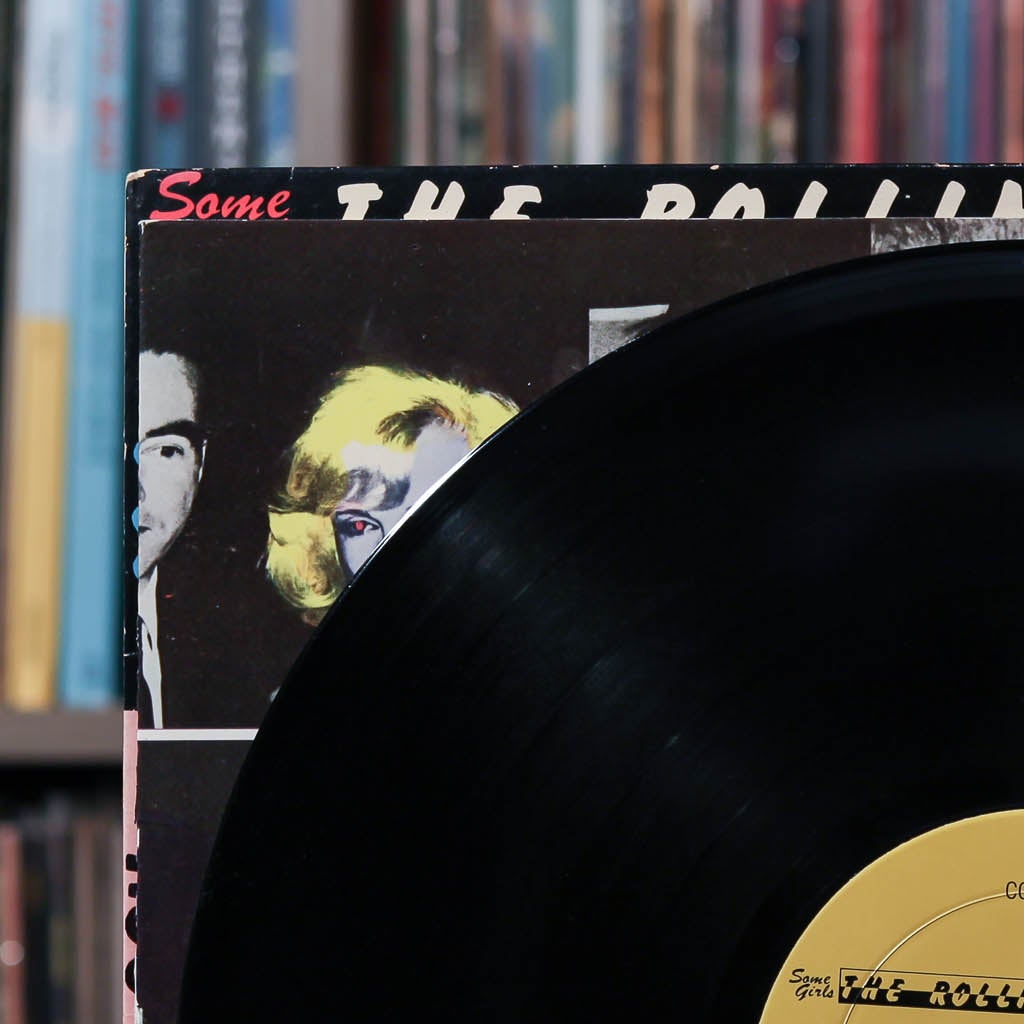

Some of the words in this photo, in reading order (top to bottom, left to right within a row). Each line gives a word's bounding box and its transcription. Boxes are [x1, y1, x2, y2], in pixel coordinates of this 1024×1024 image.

[150, 171, 291, 220] Some
[789, 968, 831, 985] Some
[795, 983, 834, 999] Girls
[841, 975, 905, 1002] THE
